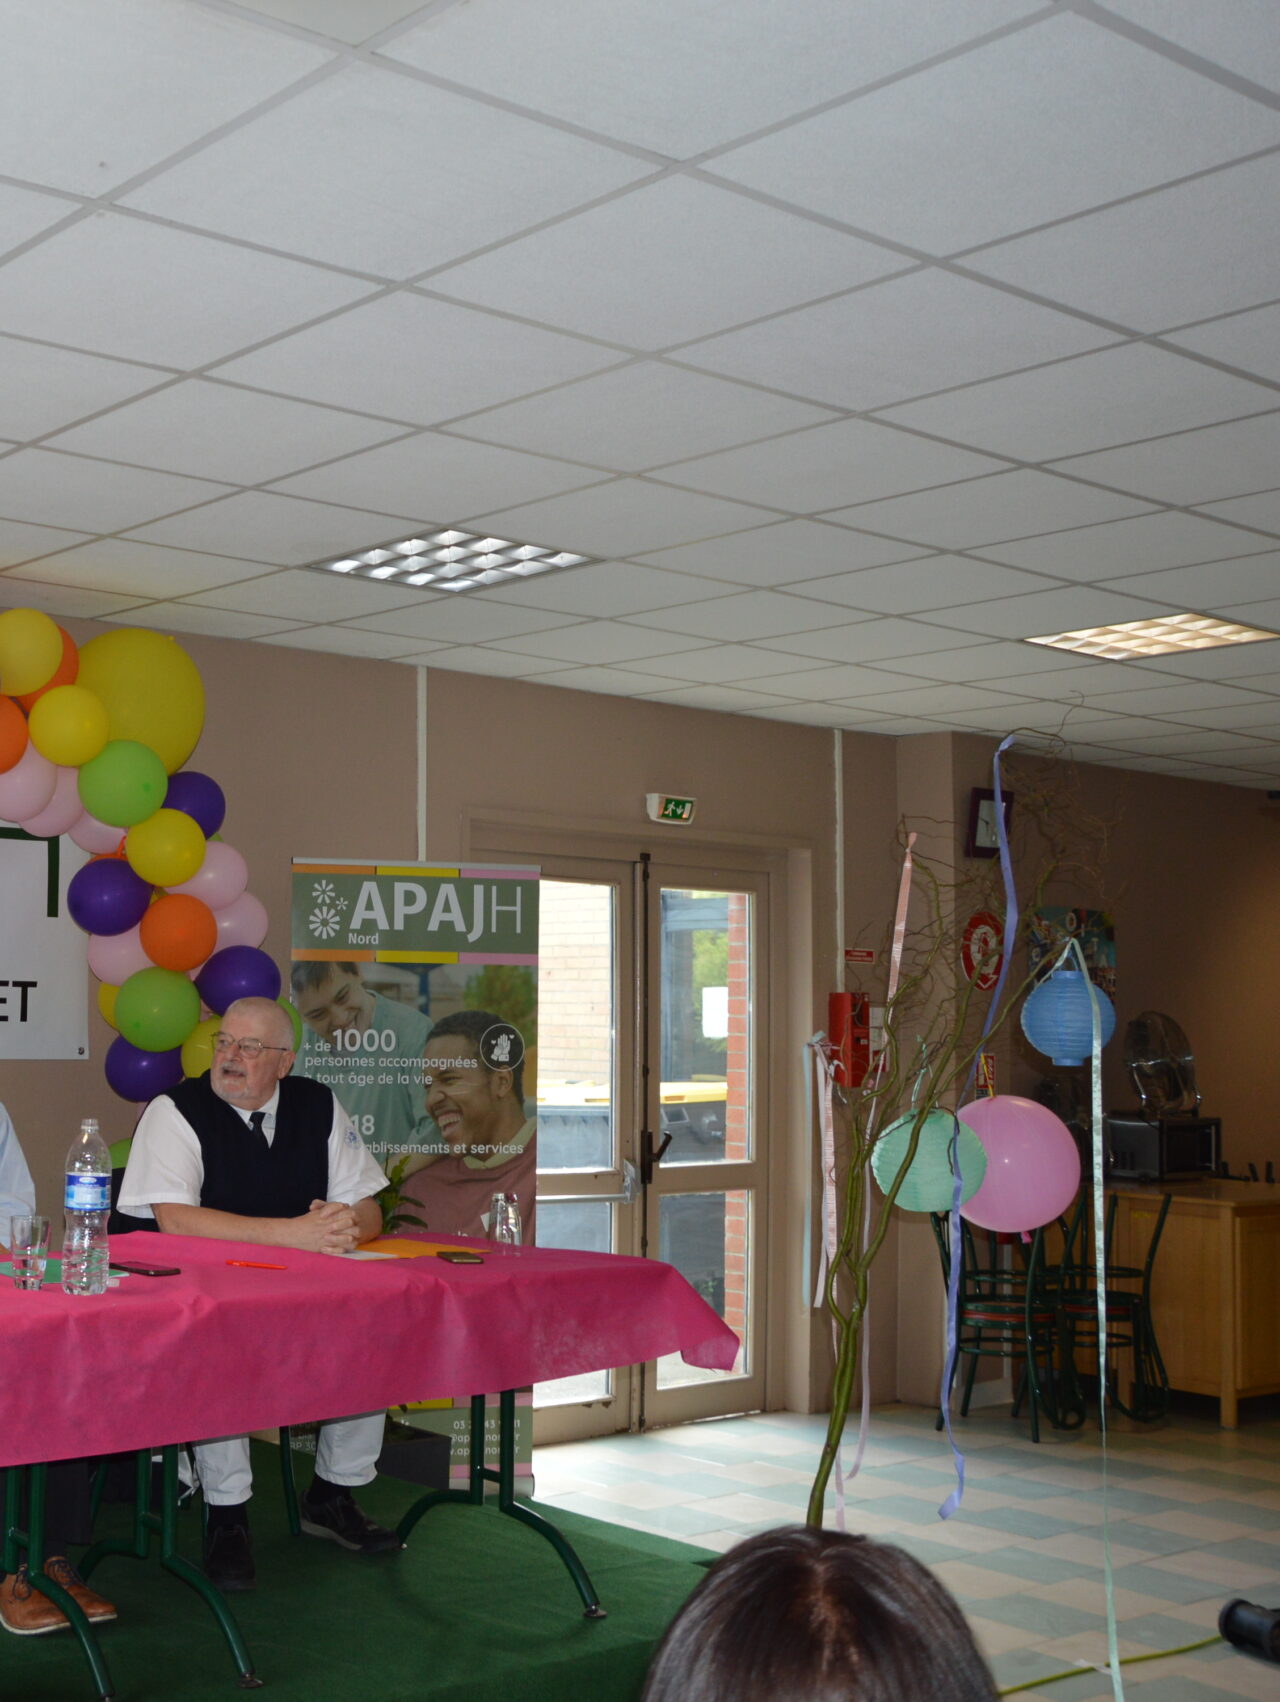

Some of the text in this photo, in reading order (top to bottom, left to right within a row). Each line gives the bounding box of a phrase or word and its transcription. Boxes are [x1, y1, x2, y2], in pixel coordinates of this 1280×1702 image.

[349, 881, 522, 943] APAJH
[348, 932, 379, 945] Nord
[314, 1041, 331, 1052] de
[332, 1029, 396, 1052] 1000
[305, 1056, 478, 1070] personnes accompagnées
[317, 1074, 344, 1085] tout
[348, 1072, 374, 1087] âge
[377, 1073, 393, 1085] de
[397, 1072, 409, 1085] la
[414, 1073, 433, 1085] vie
[453, 1144, 467, 1154] et
[470, 1141, 524, 1154] services
